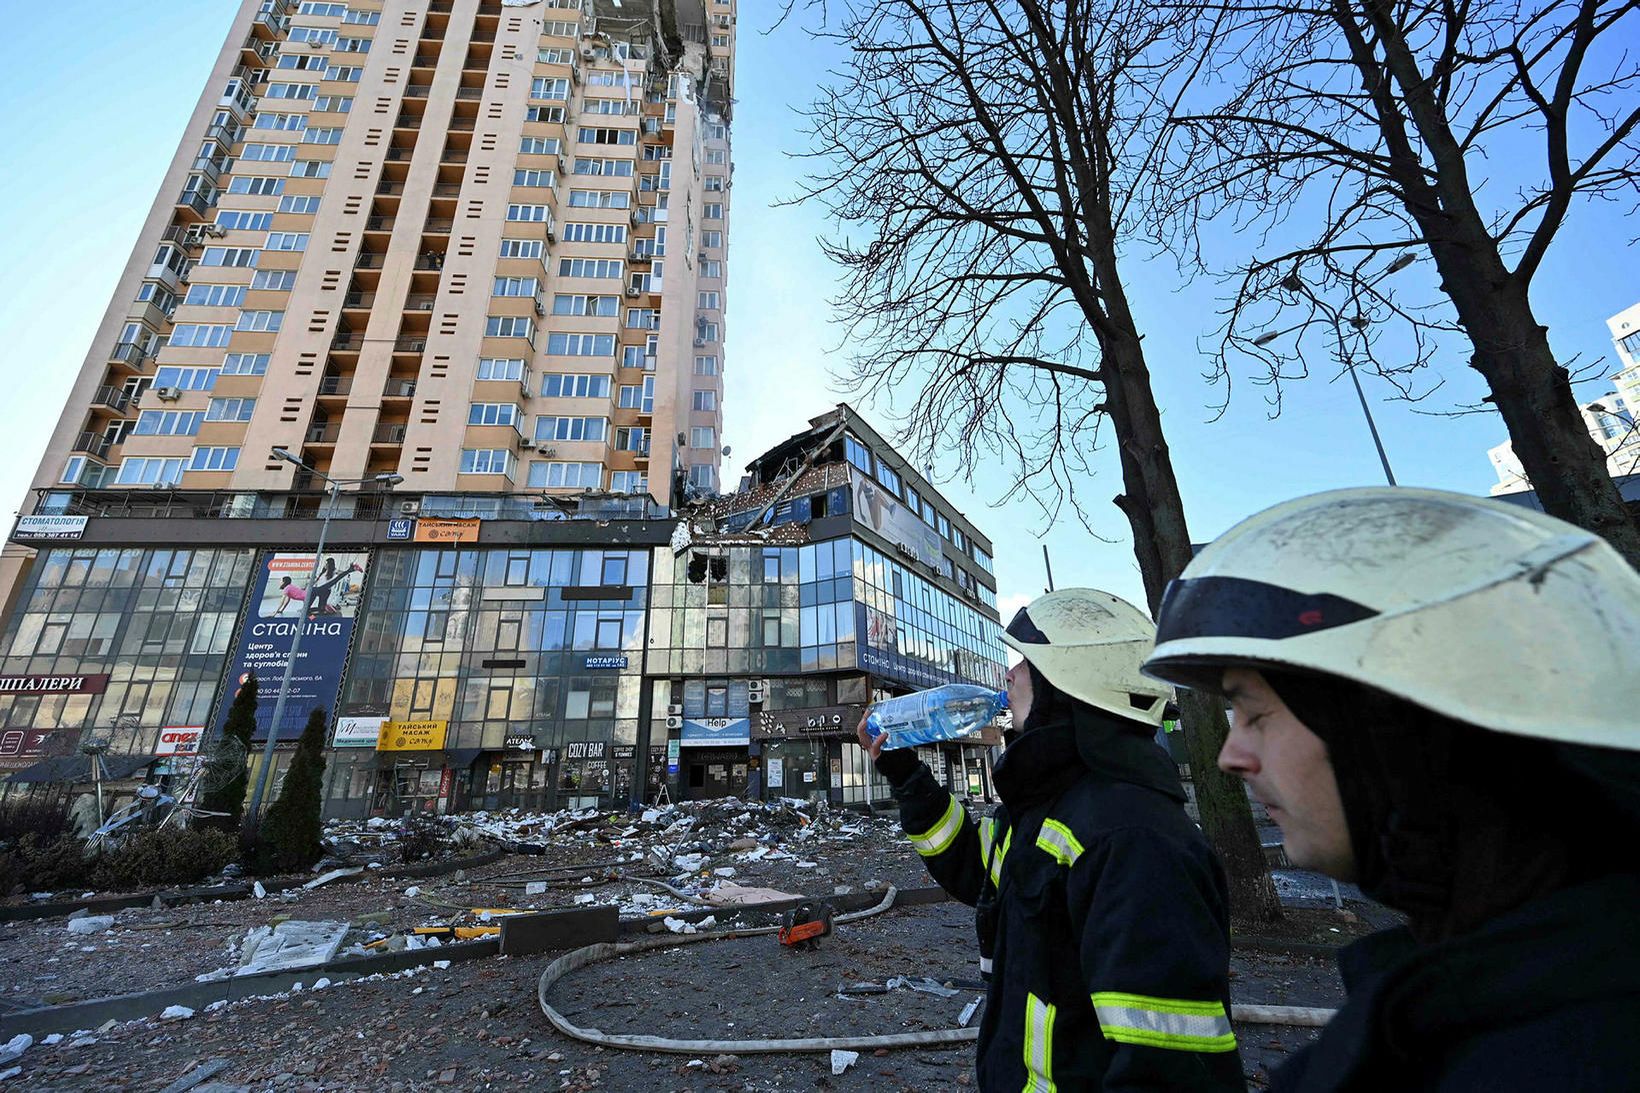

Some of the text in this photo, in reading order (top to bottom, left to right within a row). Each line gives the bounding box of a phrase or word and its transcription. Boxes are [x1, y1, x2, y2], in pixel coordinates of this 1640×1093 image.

[21, 517, 85, 526] СТОМАТОЛОГІЯ
[245, 651, 281, 659] здоров'я
[568, 742, 604, 758] COZY BAR
